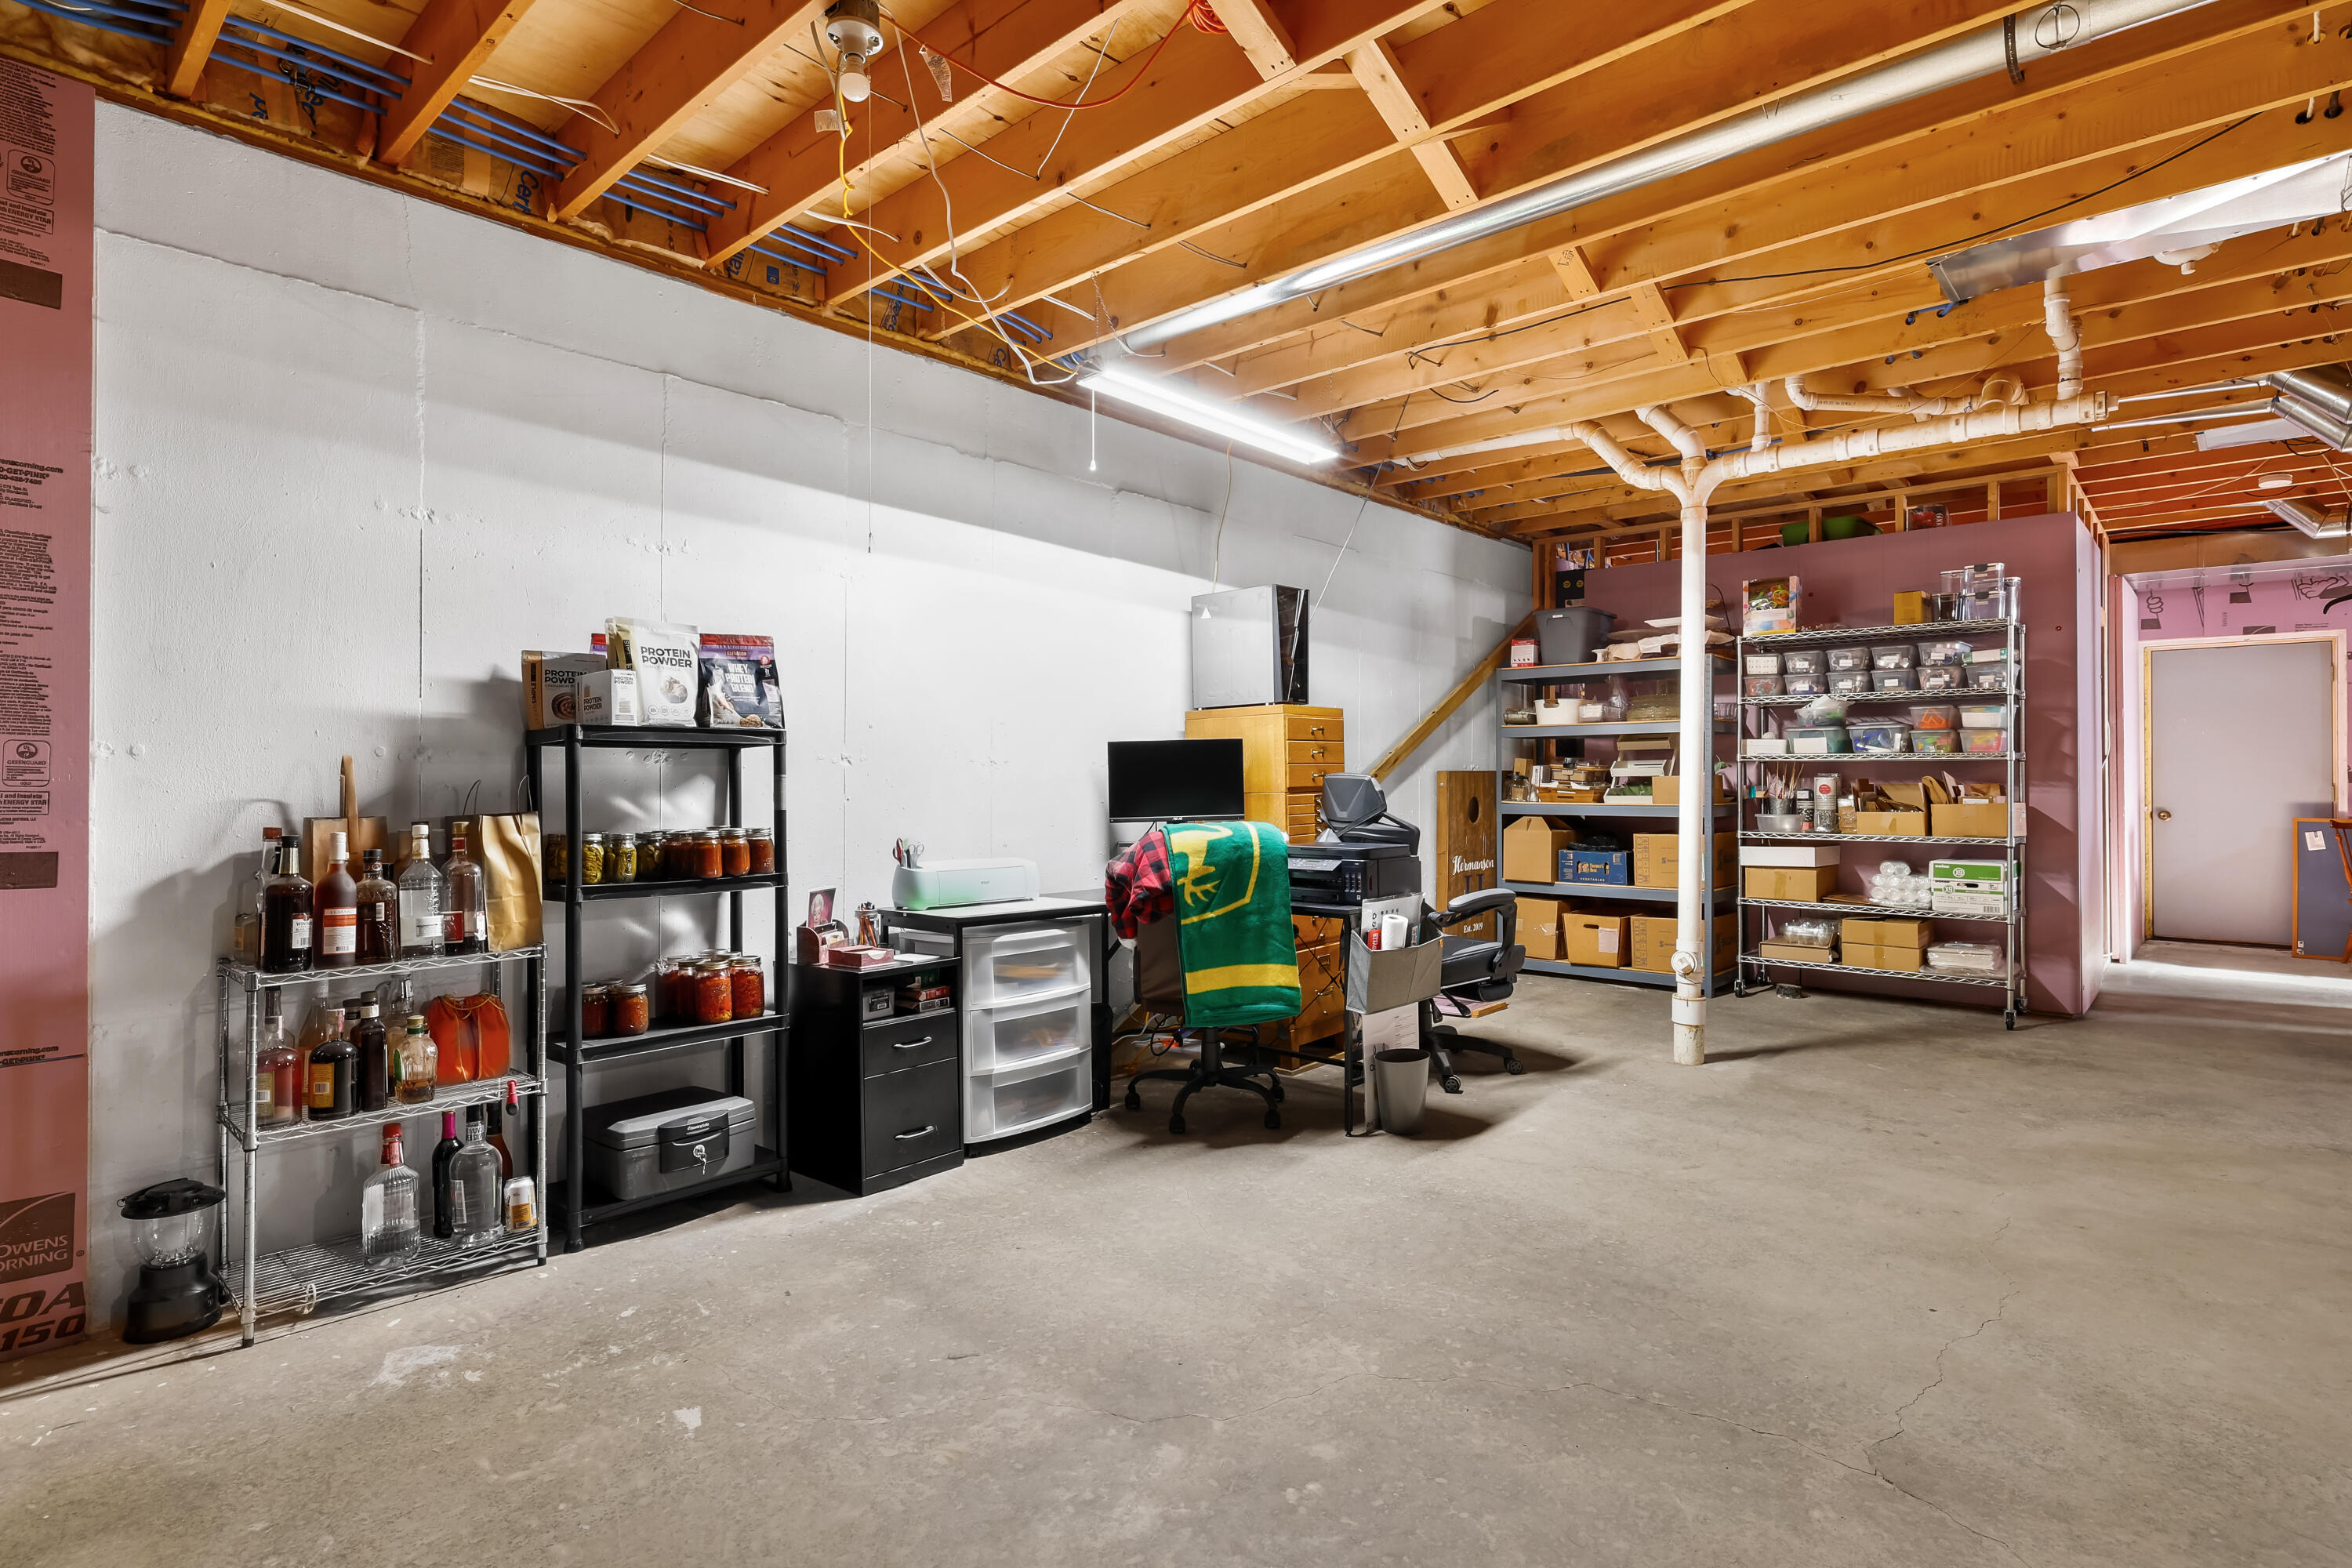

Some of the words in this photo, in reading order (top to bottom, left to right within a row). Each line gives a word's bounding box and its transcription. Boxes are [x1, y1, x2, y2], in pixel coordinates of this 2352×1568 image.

[11, 169, 51, 183] GREENGUARD
[22, 205, 47, 216] Insulate
[8, 209, 34, 220] ENERGY
[34, 216, 51, 225] STAR
[641, 645, 691, 659] PROTEIN
[641, 655, 692, 668] POWDER
[727, 662, 749, 673] WHEY
[725, 673, 755, 684] PROTEIN
[730, 683, 755, 693] BLEND
[583, 695, 603, 705] PROTEIN
[583, 702, 603, 711] POWDER
[1452, 855, 1494, 876] Hermanson
[1463, 924, 1472, 934] Est.
[1472, 922, 1483, 931] 2019
[0, 1235, 69, 1258] OWENS
